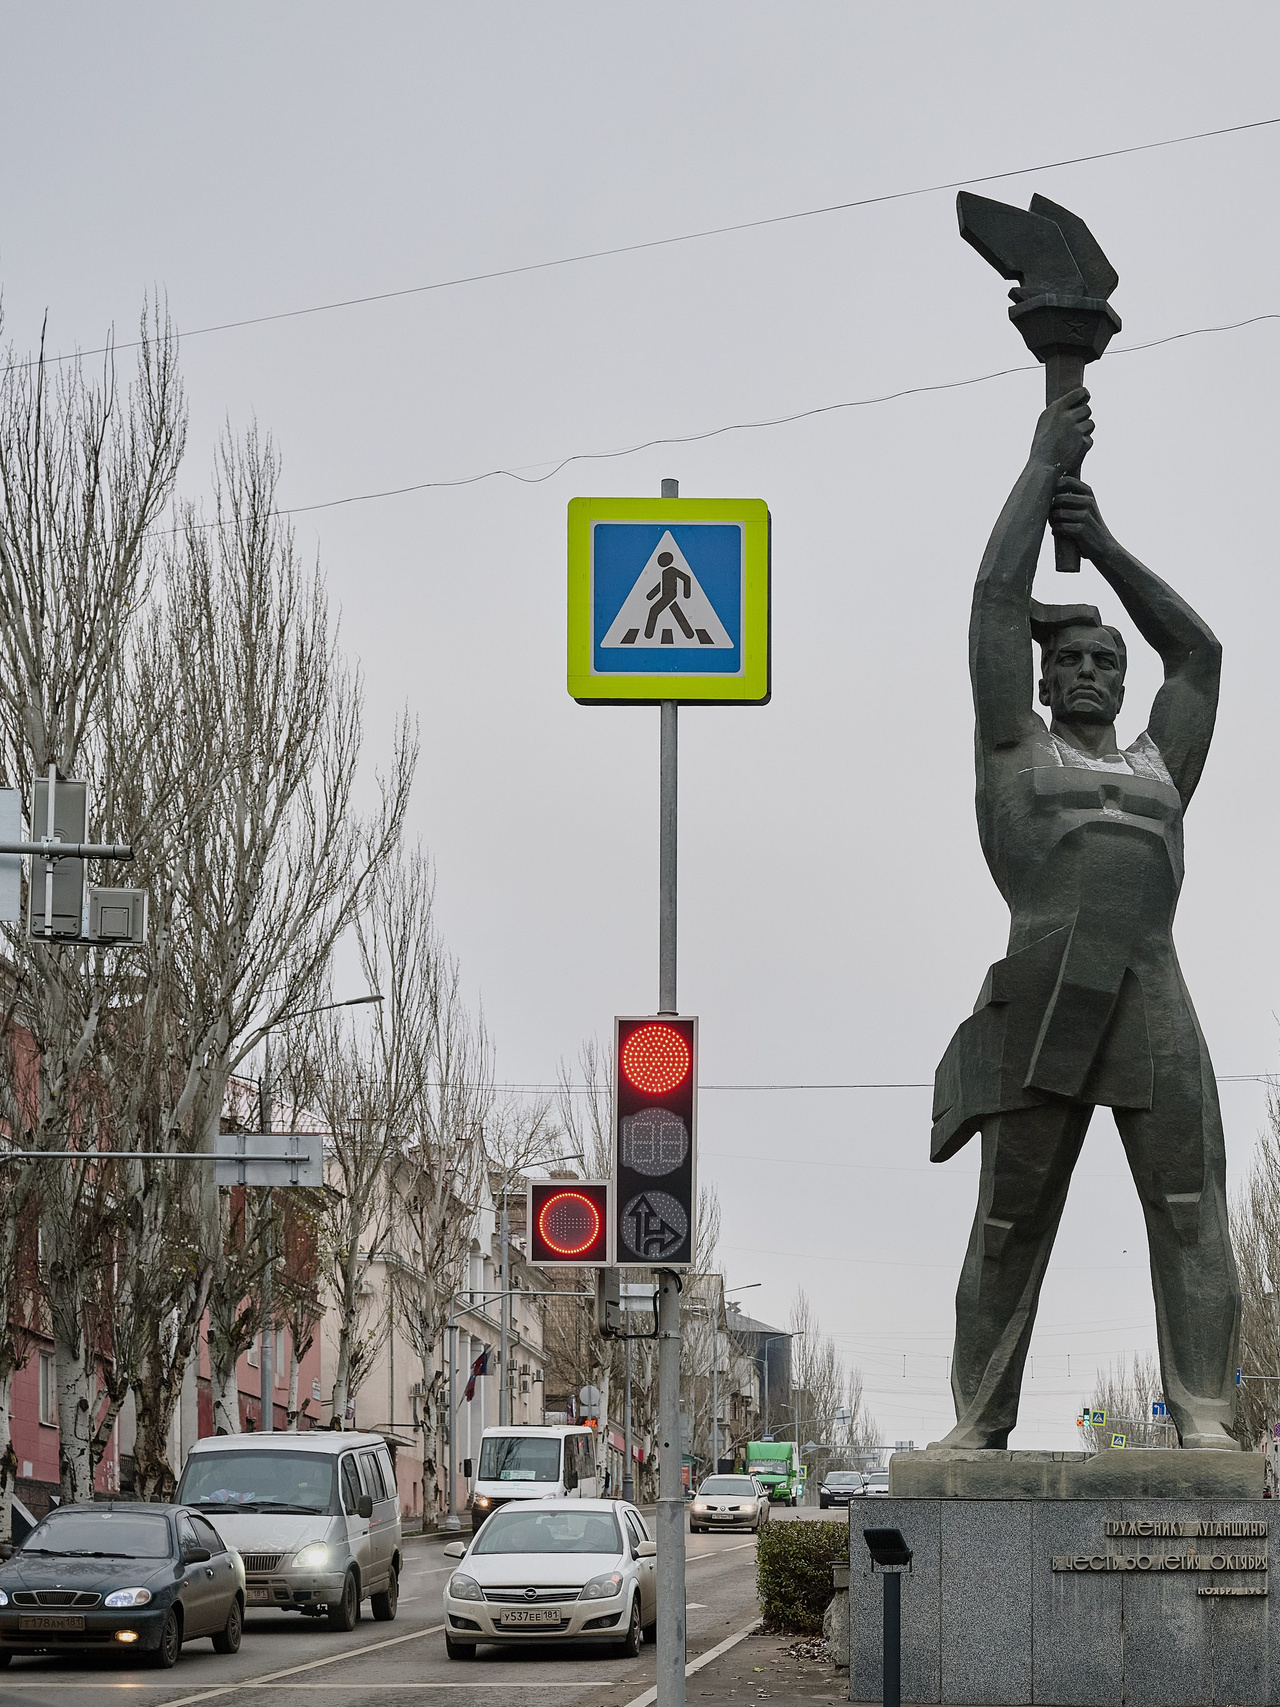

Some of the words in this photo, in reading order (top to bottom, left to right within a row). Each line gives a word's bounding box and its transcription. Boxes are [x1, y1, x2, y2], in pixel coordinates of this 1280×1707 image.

[1106, 1520, 1184, 1536] ТРУЖЕНИКУ
[1196, 1520, 1268, 1536] ЛУГАНЩИНЫ
[1066, 1555, 1119, 1570] ЧЕСТЬ
[1125, 1555, 1152, 1570] 50
[1158, 1555, 1201, 1570] ЛЕТИЯ
[1210, 1554, 1268, 1570] ОКТЯБРЯ
[1198, 1587, 1236, 1595] НОЯБРЬ
[1245, 1587, 1268, 1595] 1967
